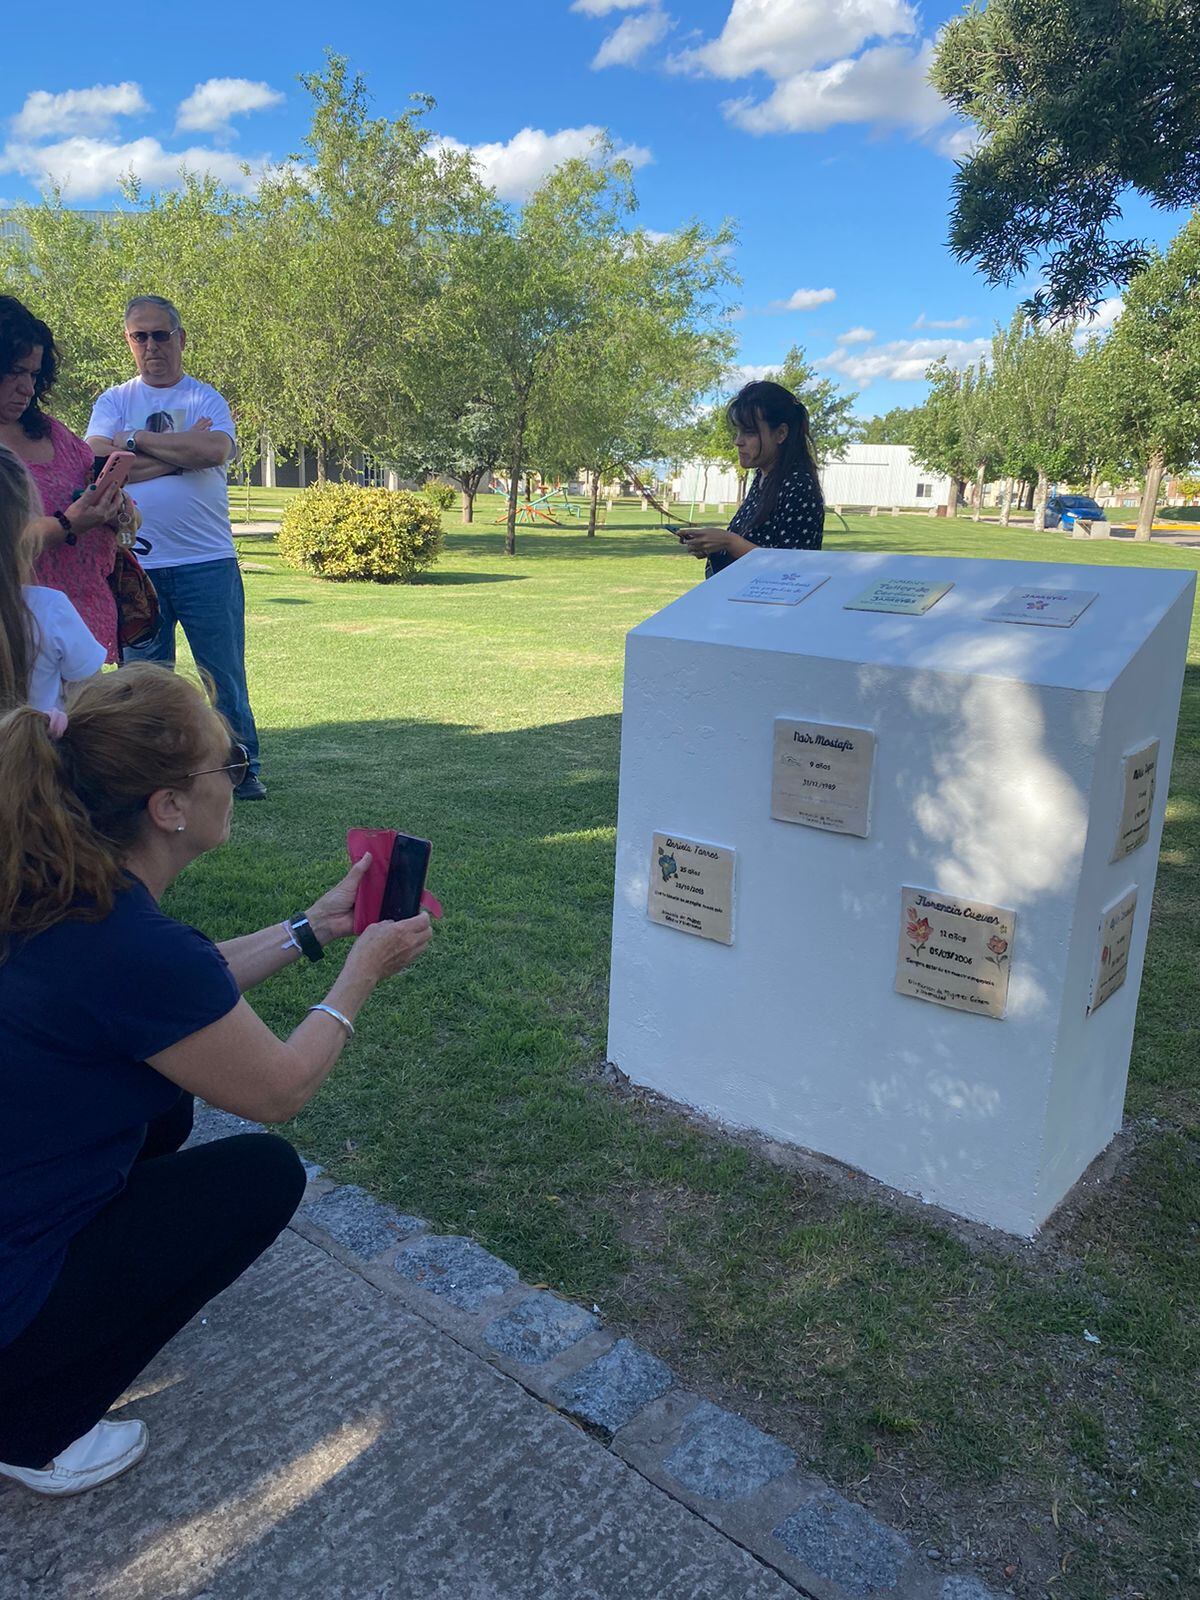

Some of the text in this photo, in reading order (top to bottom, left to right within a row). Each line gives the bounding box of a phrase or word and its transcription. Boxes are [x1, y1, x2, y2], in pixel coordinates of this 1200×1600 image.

[814, 734, 854, 752] Mostafa
[809, 760, 832, 771] 9 años
[666, 838, 692, 853] Daniela
[916, 895, 1000, 926] Florencia Cuevas
[948, 932, 966, 943] años
[929, 946, 973, 965] 05/03/2006
